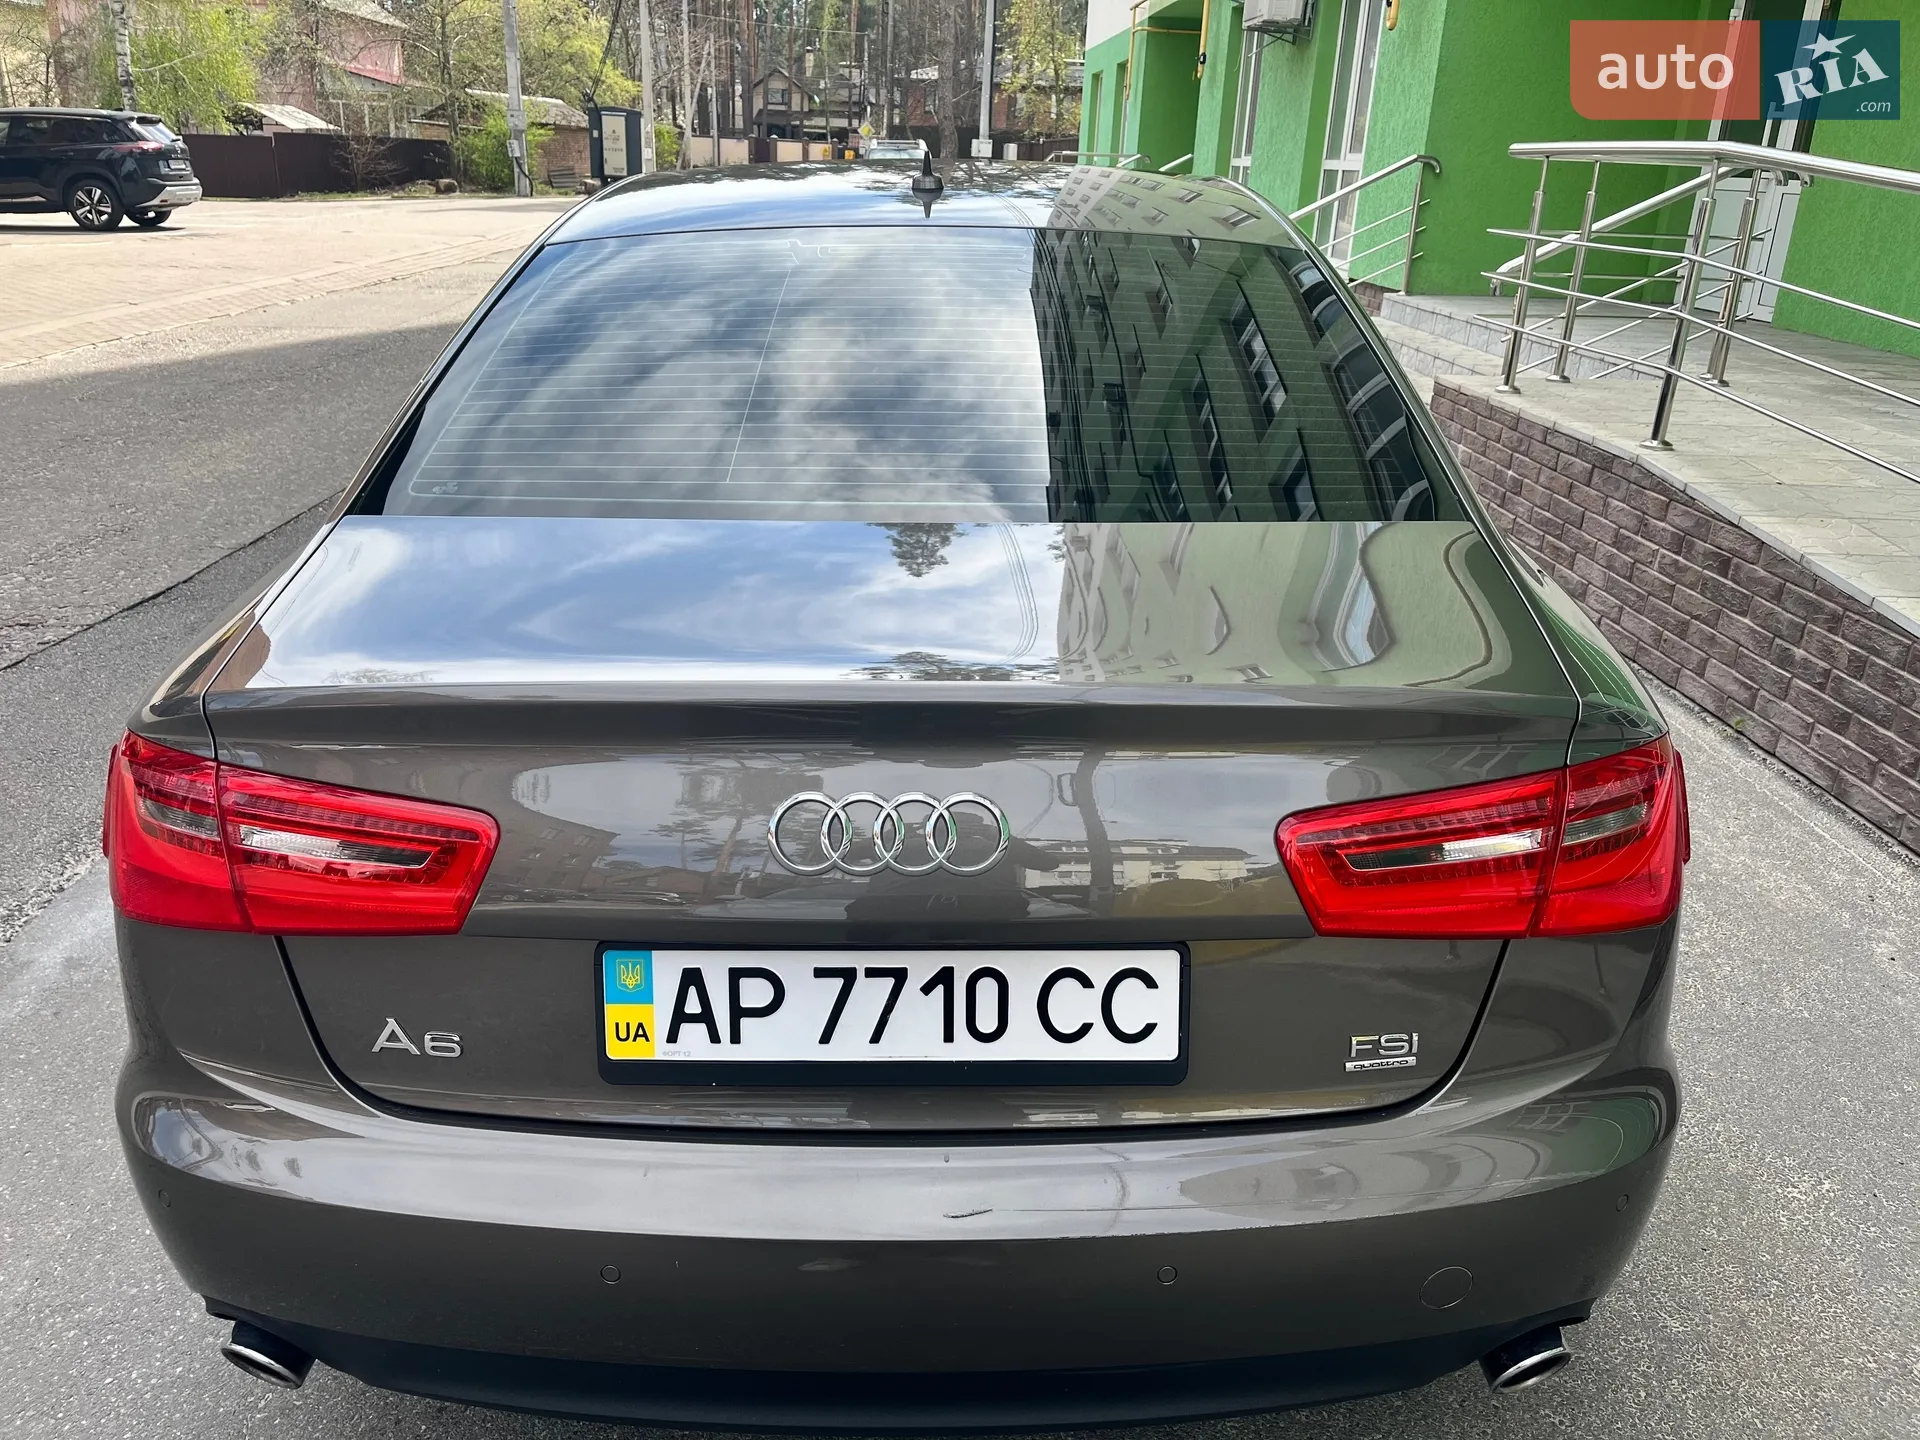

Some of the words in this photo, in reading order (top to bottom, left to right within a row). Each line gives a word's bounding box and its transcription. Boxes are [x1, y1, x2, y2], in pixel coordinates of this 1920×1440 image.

[666, 966, 785, 1045] AP
[813, 965, 1010, 1045] 7710
[1036, 966, 1159, 1044] CC
[371, 1017, 462, 1058] A6
[615, 1021, 651, 1043] UA
[1350, 1032, 1419, 1058] FSI
[1353, 1059, 1409, 1070] quattro
